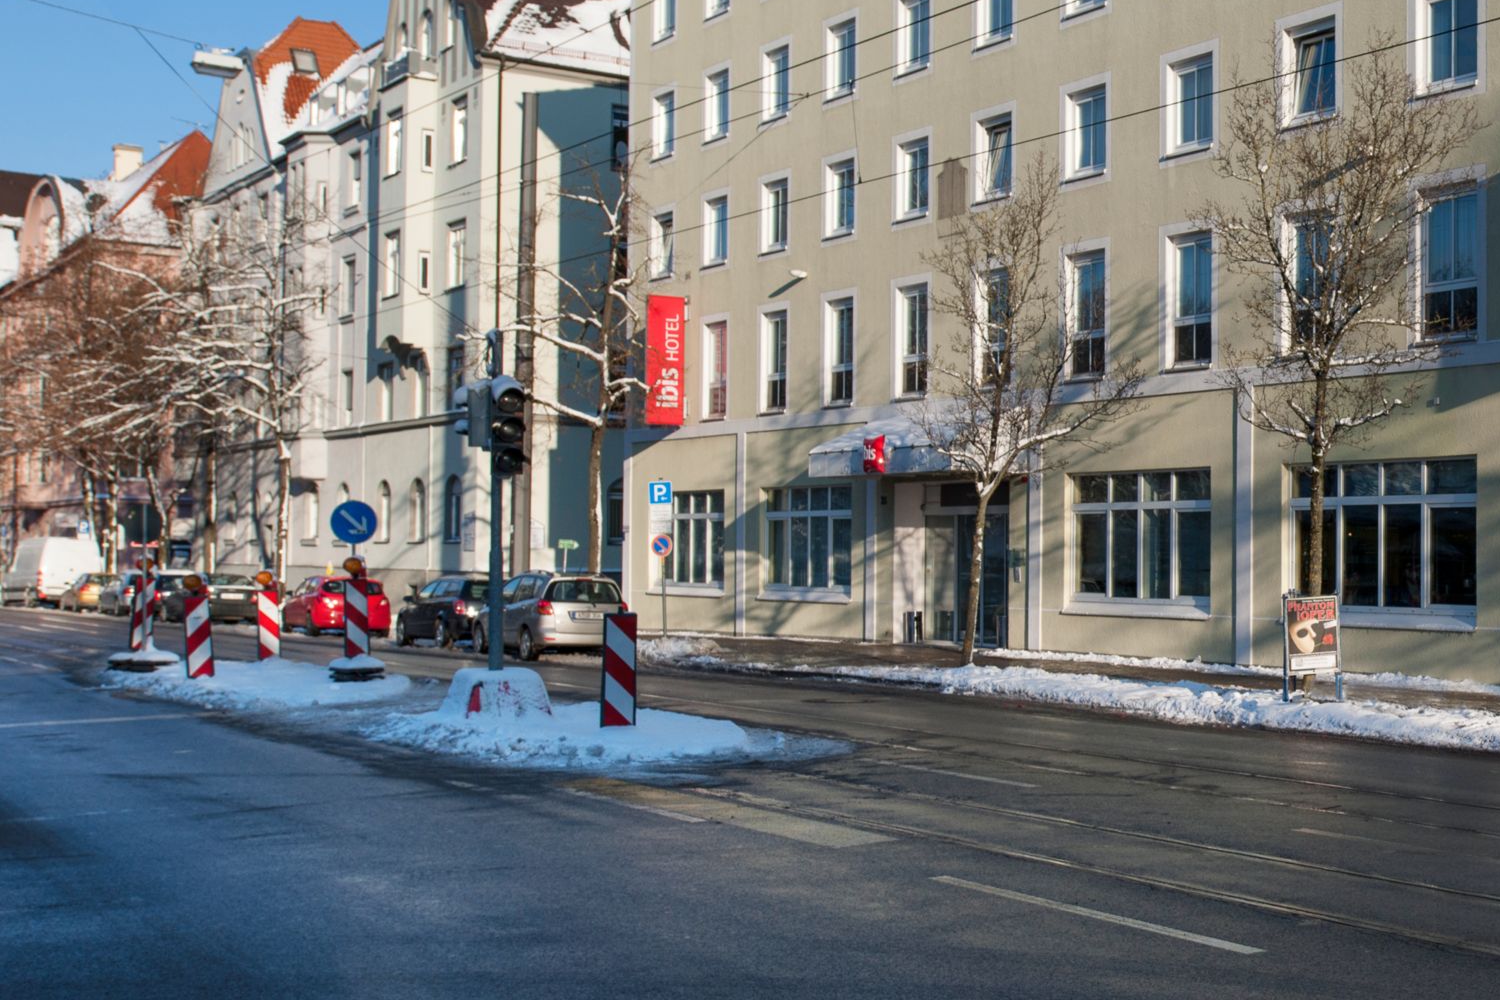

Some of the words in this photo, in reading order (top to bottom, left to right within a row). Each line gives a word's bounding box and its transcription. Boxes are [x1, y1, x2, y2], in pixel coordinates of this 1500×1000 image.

[665, 314, 680, 362] HOTEL
[656, 368, 679, 409] ibis
[654, 484, 667, 502] P
[1287, 600, 1335, 612] PHANTOM
